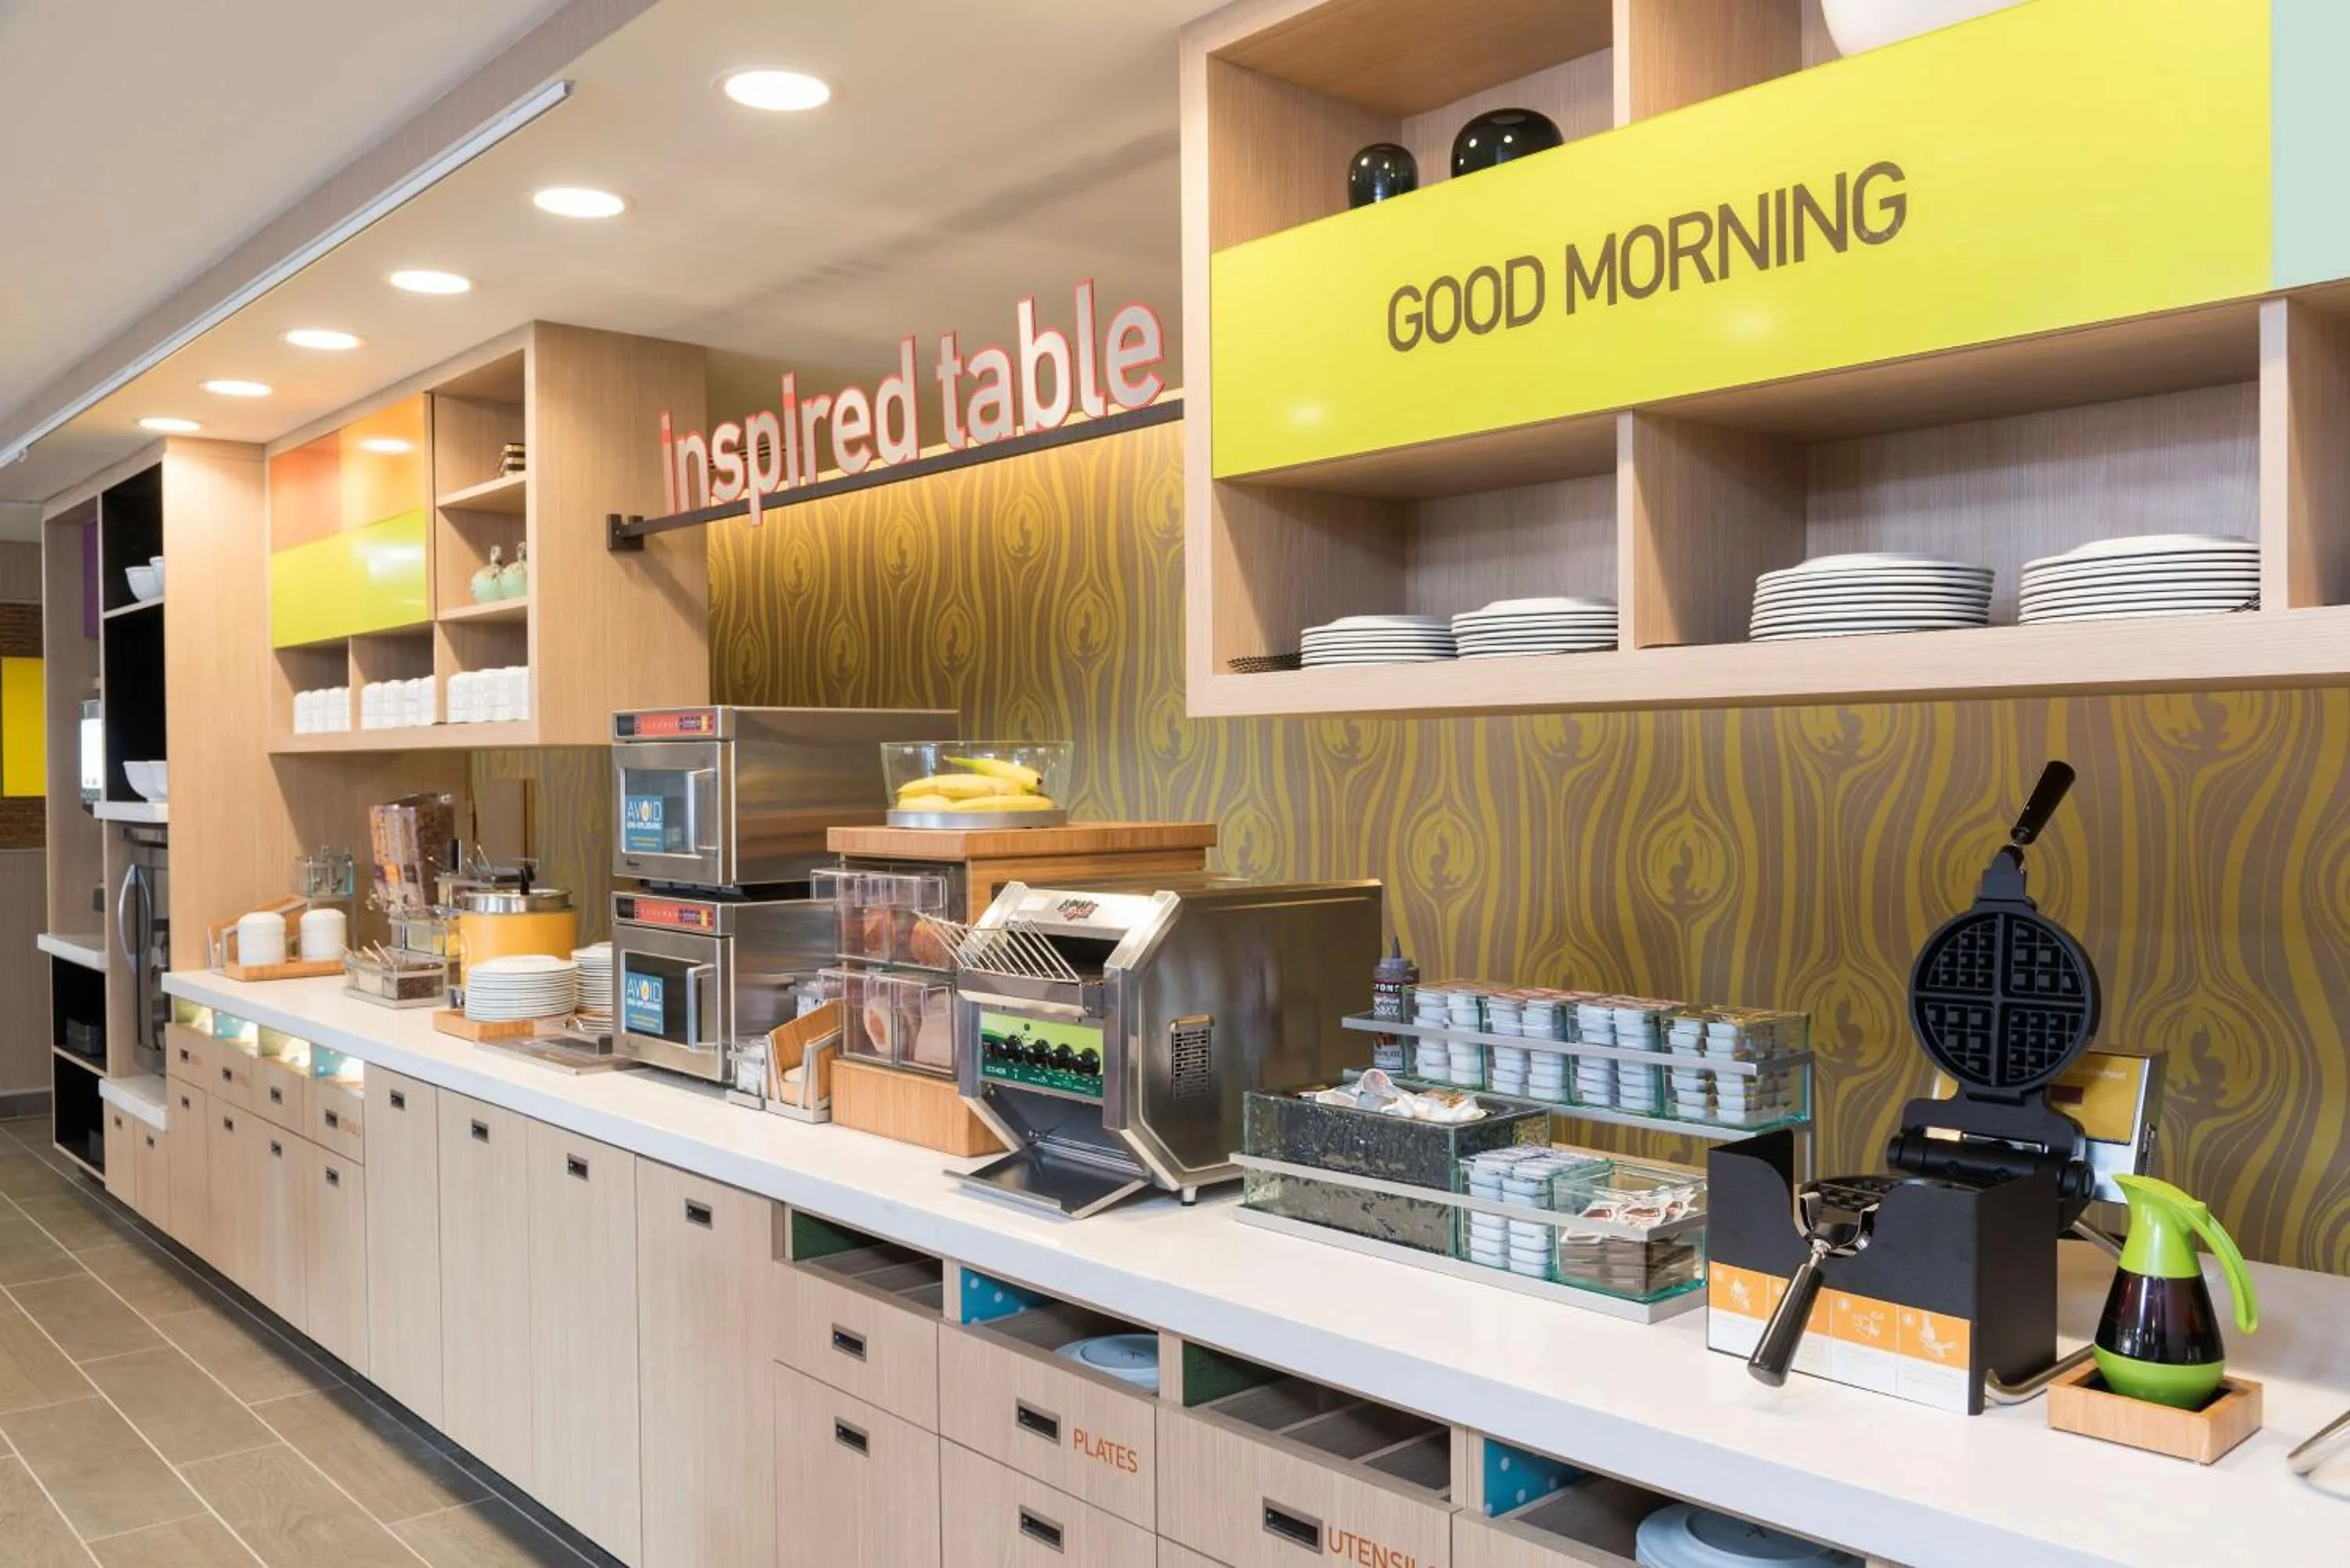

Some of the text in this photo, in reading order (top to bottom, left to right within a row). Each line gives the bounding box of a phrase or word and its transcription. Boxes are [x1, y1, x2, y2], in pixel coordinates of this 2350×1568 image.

[1387, 161, 1907, 352] GOOD MORNING
[660, 278, 1165, 527] inspired table
[1074, 1428, 1137, 1473] PLATES
[1328, 1526, 1437, 1568] UTENS
